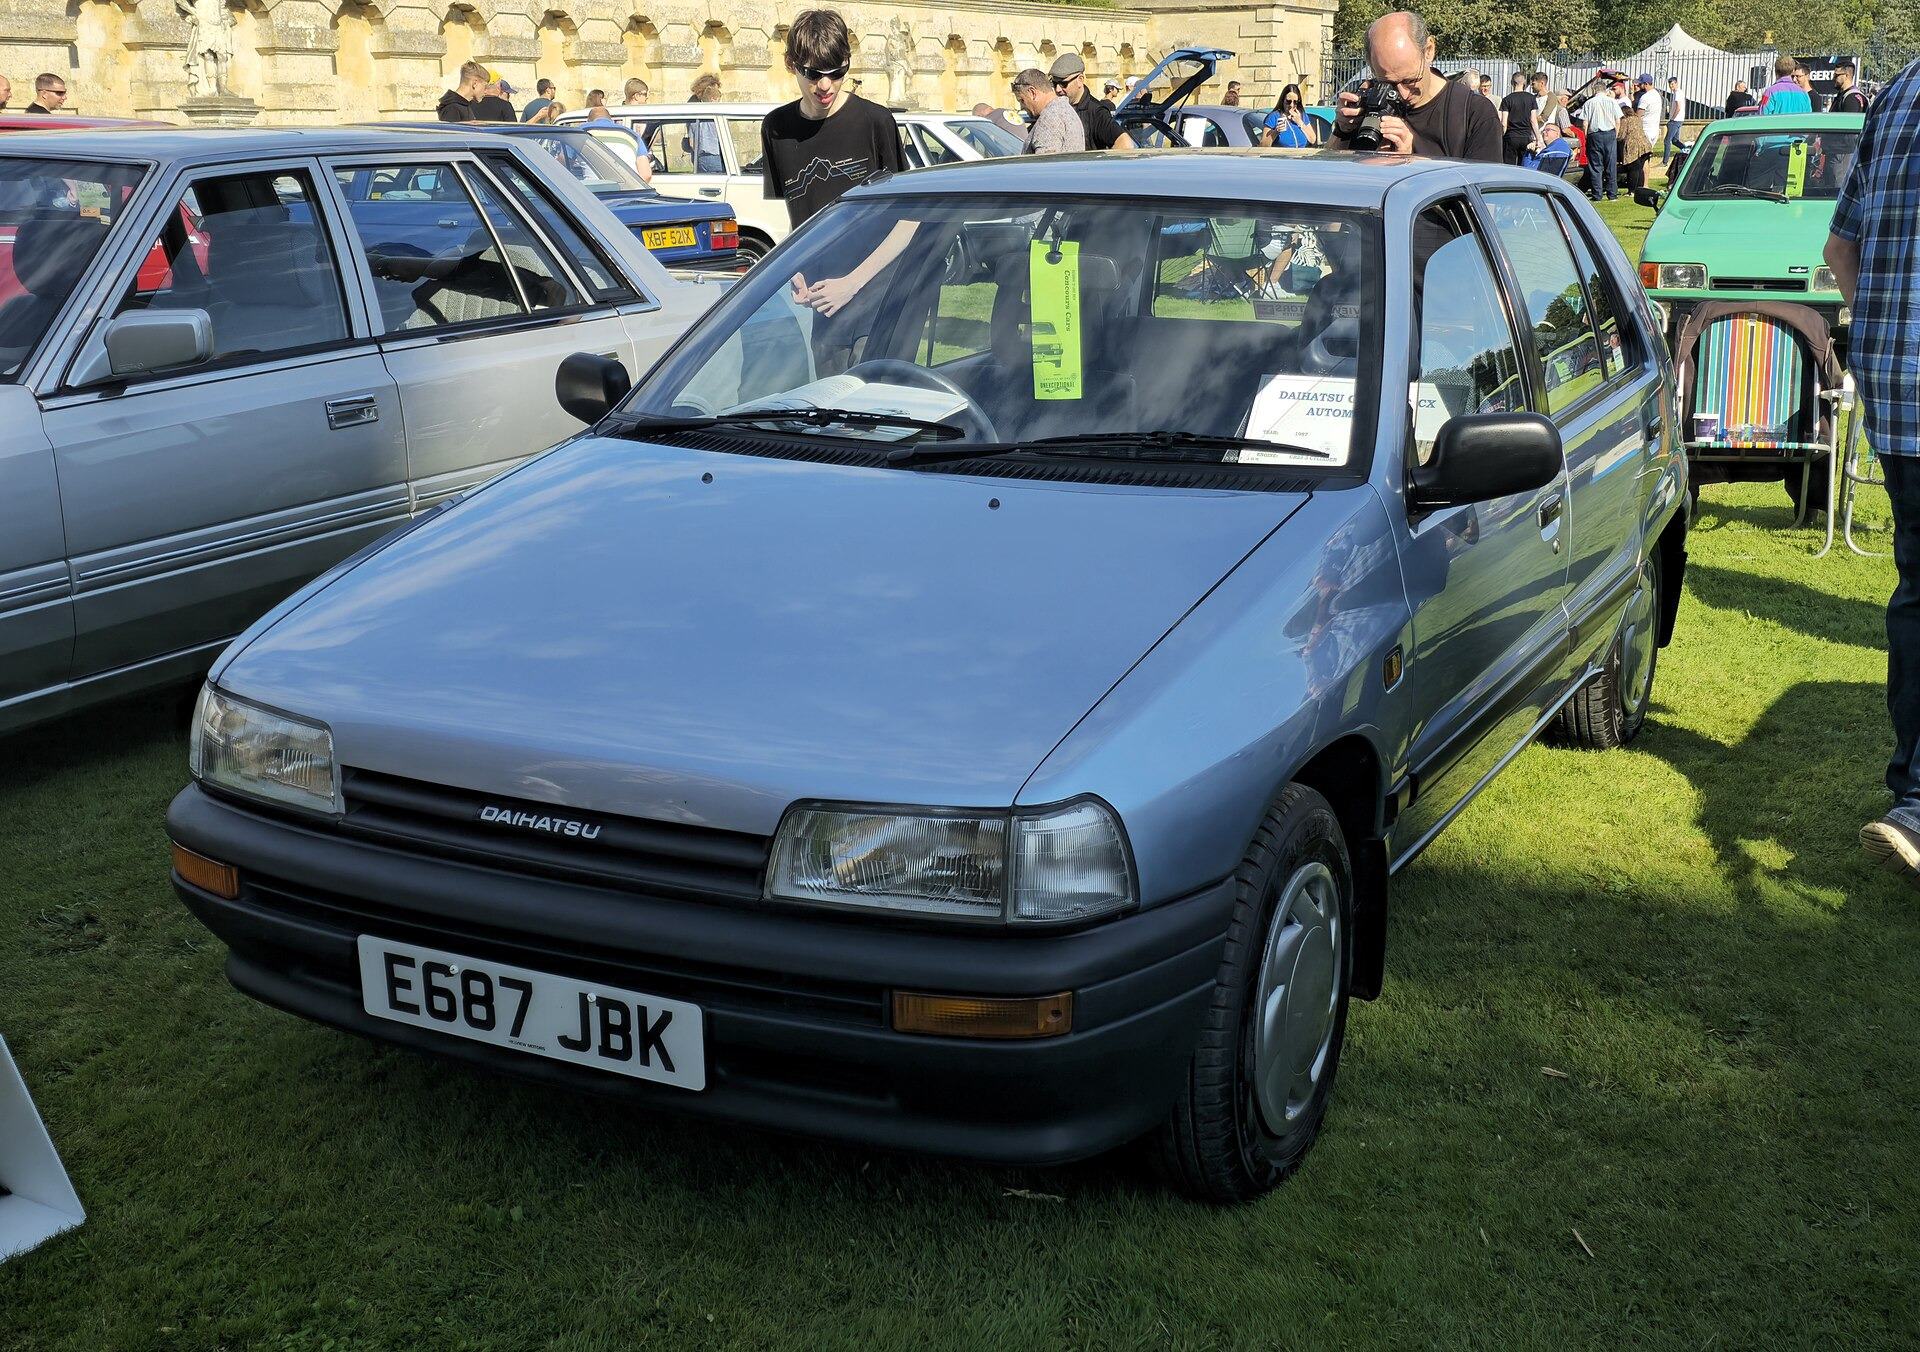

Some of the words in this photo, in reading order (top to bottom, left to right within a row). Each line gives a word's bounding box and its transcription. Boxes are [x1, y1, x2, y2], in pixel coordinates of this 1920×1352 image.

[1809, 70, 1835, 81] GERT
[646, 232, 666, 247] XBF
[669, 229, 692, 243] 521X
[1279, 390, 1344, 404] DAIHATSU
[1418, 399, 1436, 409] CX
[1306, 406, 1354, 419] AUTOM
[480, 806, 601, 839] DAIHATSU
[383, 952, 533, 1038] E687
[557, 991, 676, 1074] JBK
